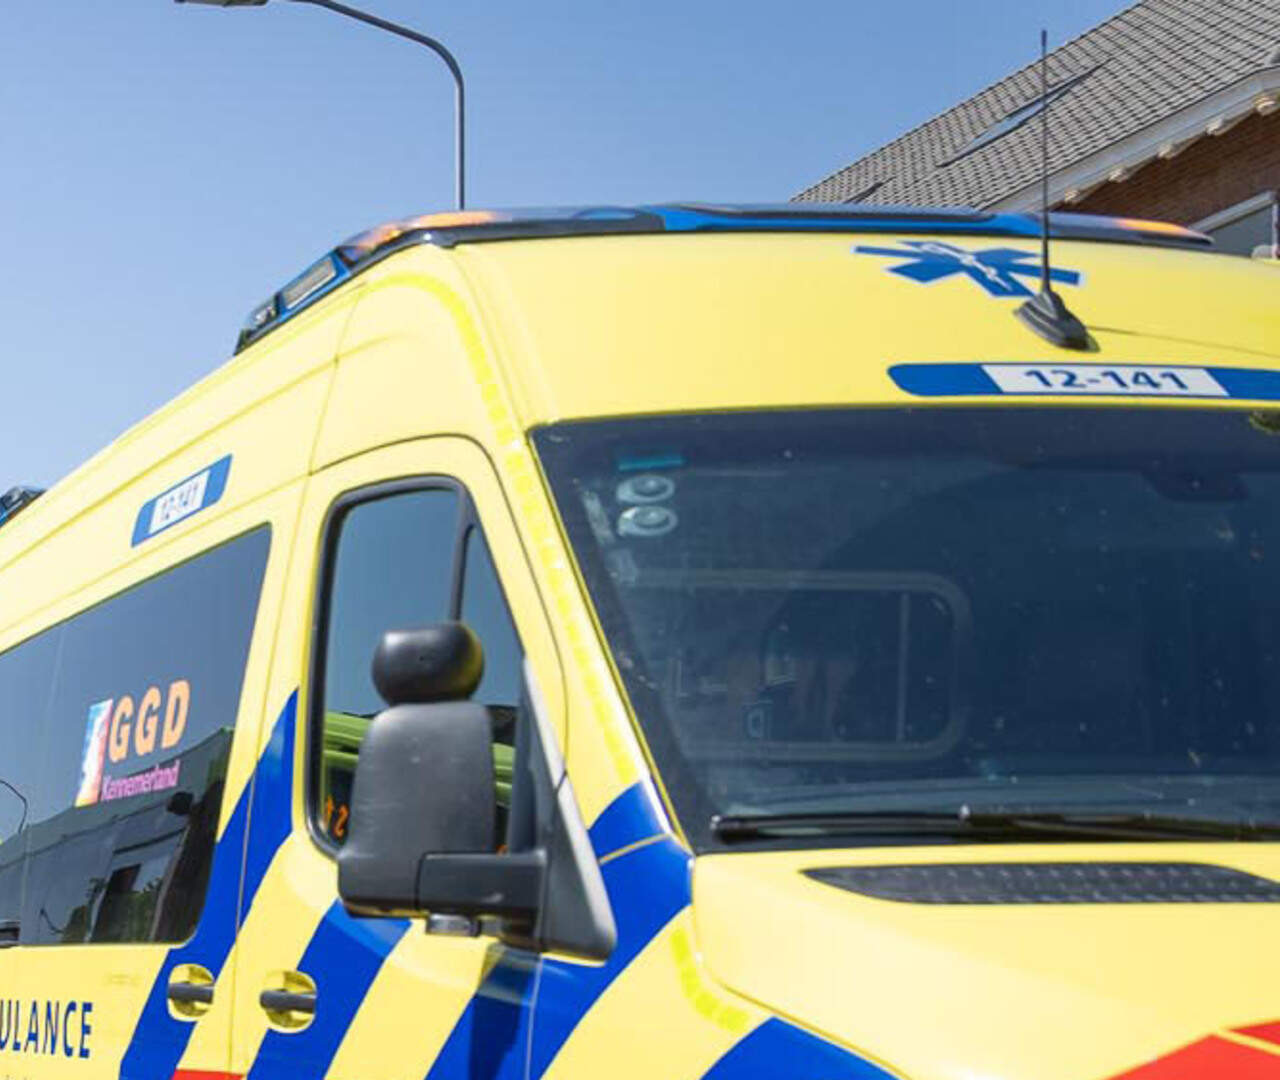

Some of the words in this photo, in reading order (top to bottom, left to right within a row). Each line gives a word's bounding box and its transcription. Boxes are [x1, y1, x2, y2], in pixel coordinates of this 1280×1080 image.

[1024, 369, 1189, 391] 12-141
[109, 679, 190, 763] GGD
[101, 759, 181, 801] Kennemerland
